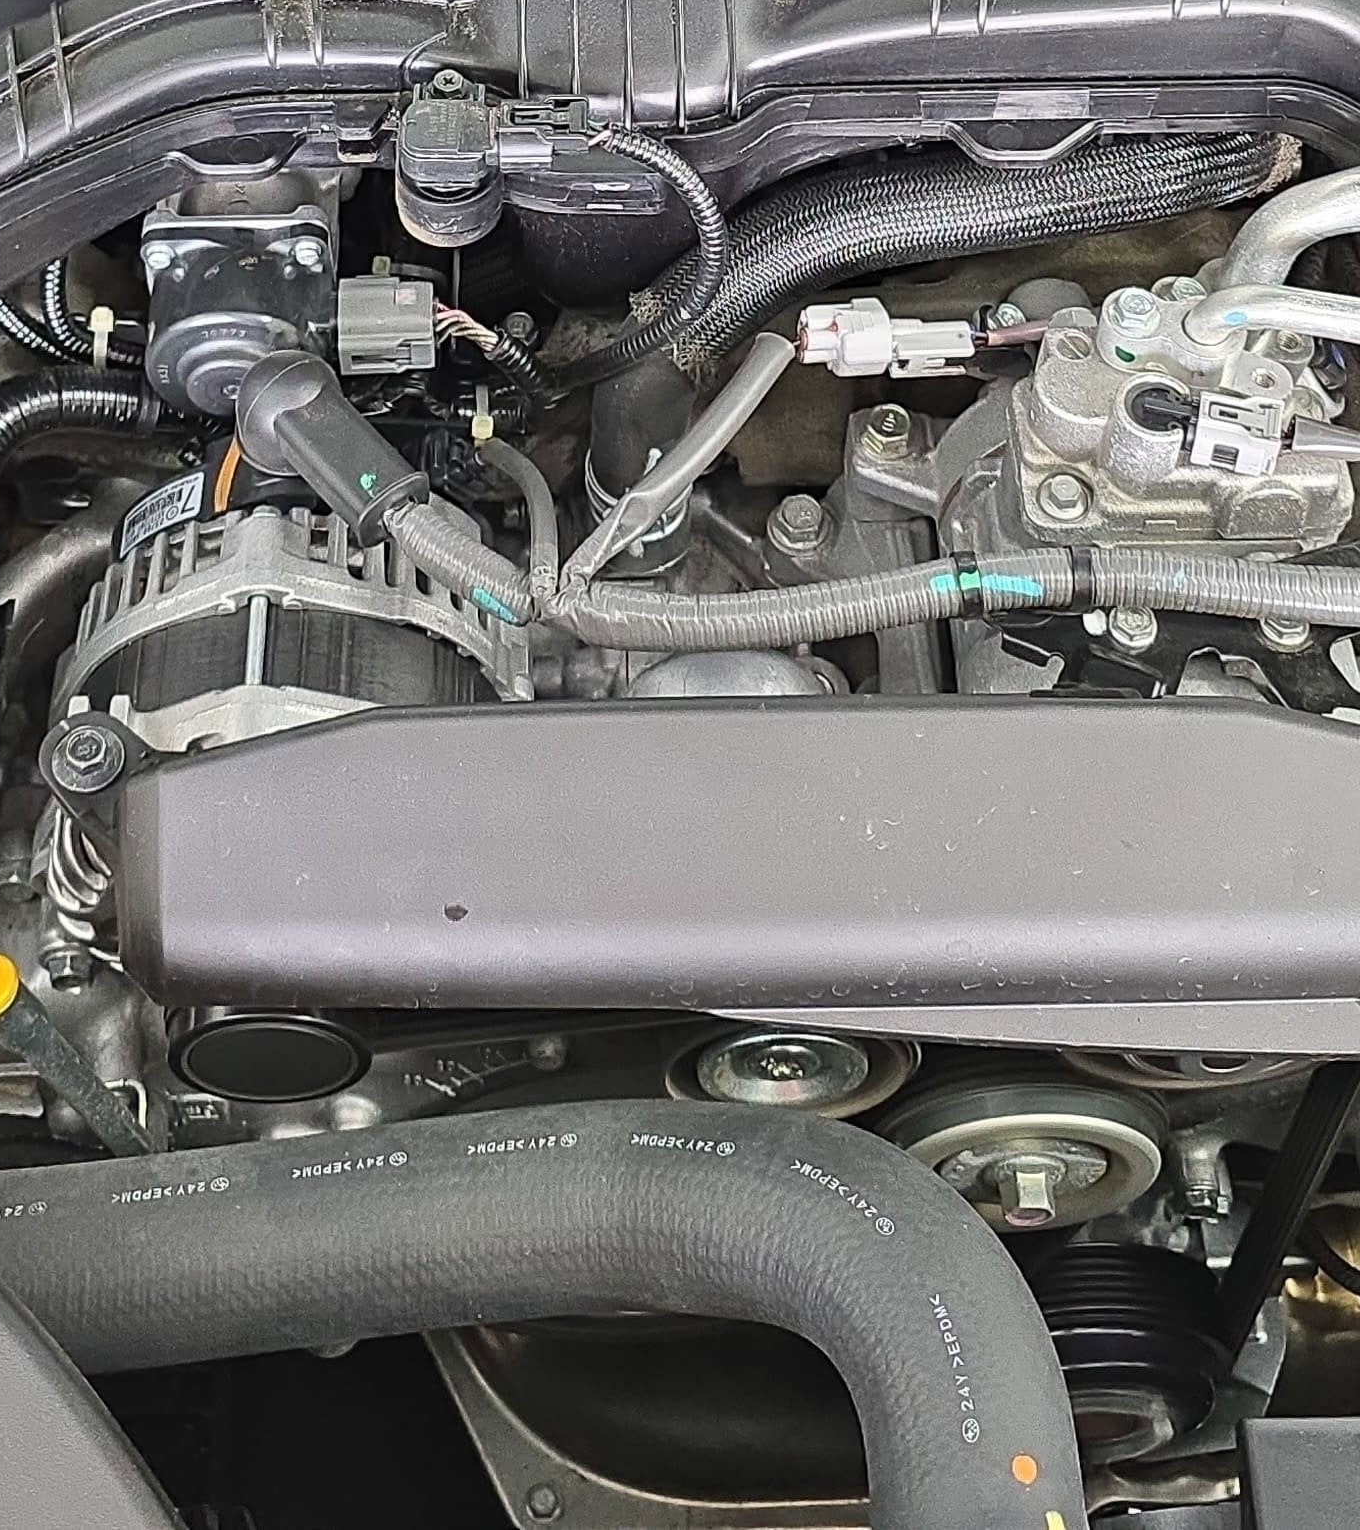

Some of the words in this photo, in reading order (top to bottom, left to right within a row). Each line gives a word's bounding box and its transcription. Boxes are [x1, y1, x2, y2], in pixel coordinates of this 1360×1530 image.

[527, 1135, 557, 1150] 24Y
[685, 1136, 714, 1152] 24Y
[355, 1154, 385, 1170] 24Y
[176, 1180, 207, 1196] 24Y
[846, 1189, 878, 1219] 24Y
[955, 1375, 975, 1412] 24Y
